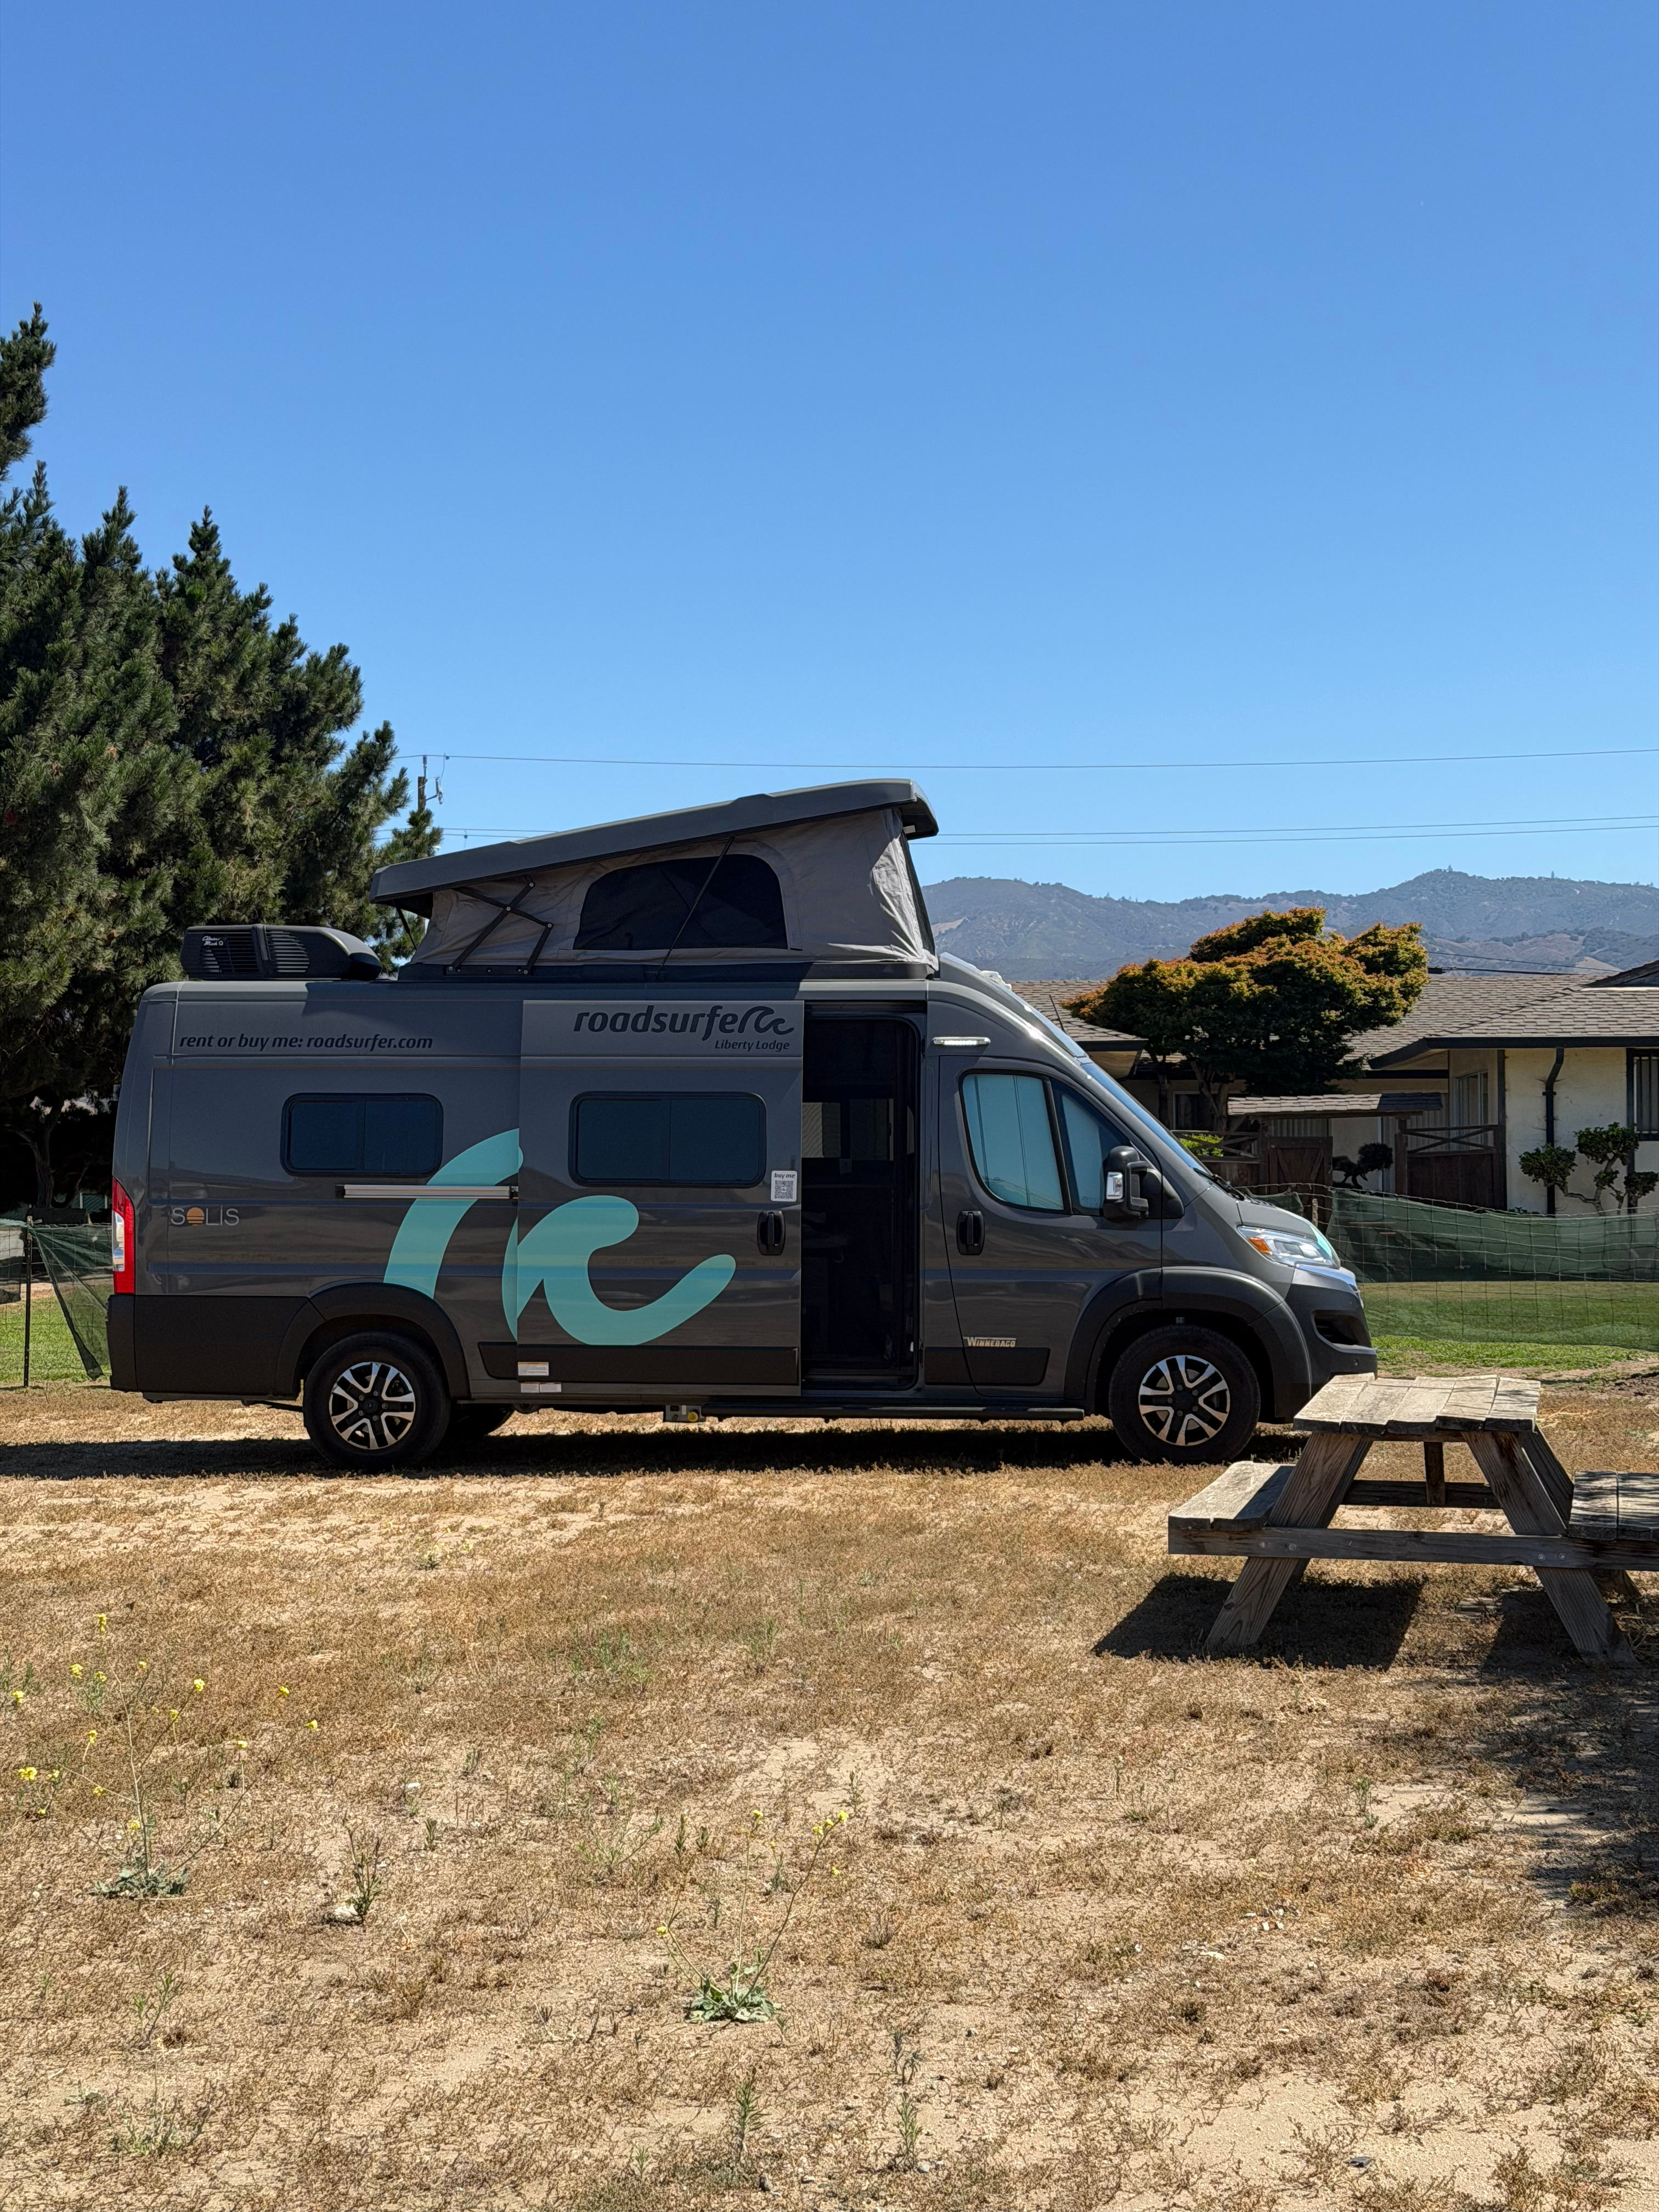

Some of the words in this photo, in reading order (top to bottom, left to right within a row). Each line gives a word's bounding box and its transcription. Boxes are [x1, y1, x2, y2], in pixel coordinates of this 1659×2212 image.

[573, 1005, 794, 1041] roadsurfer
[179, 1035, 215, 1047] rent
[217, 1037, 236, 1047] or
[238, 1033, 270, 1051] buy
[272, 1036, 303, 1047] me:
[307, 1034, 433, 1052] roadsurfer.com
[715, 1040, 754, 1052] Liberty
[755, 1040, 790, 1052] Lodge
